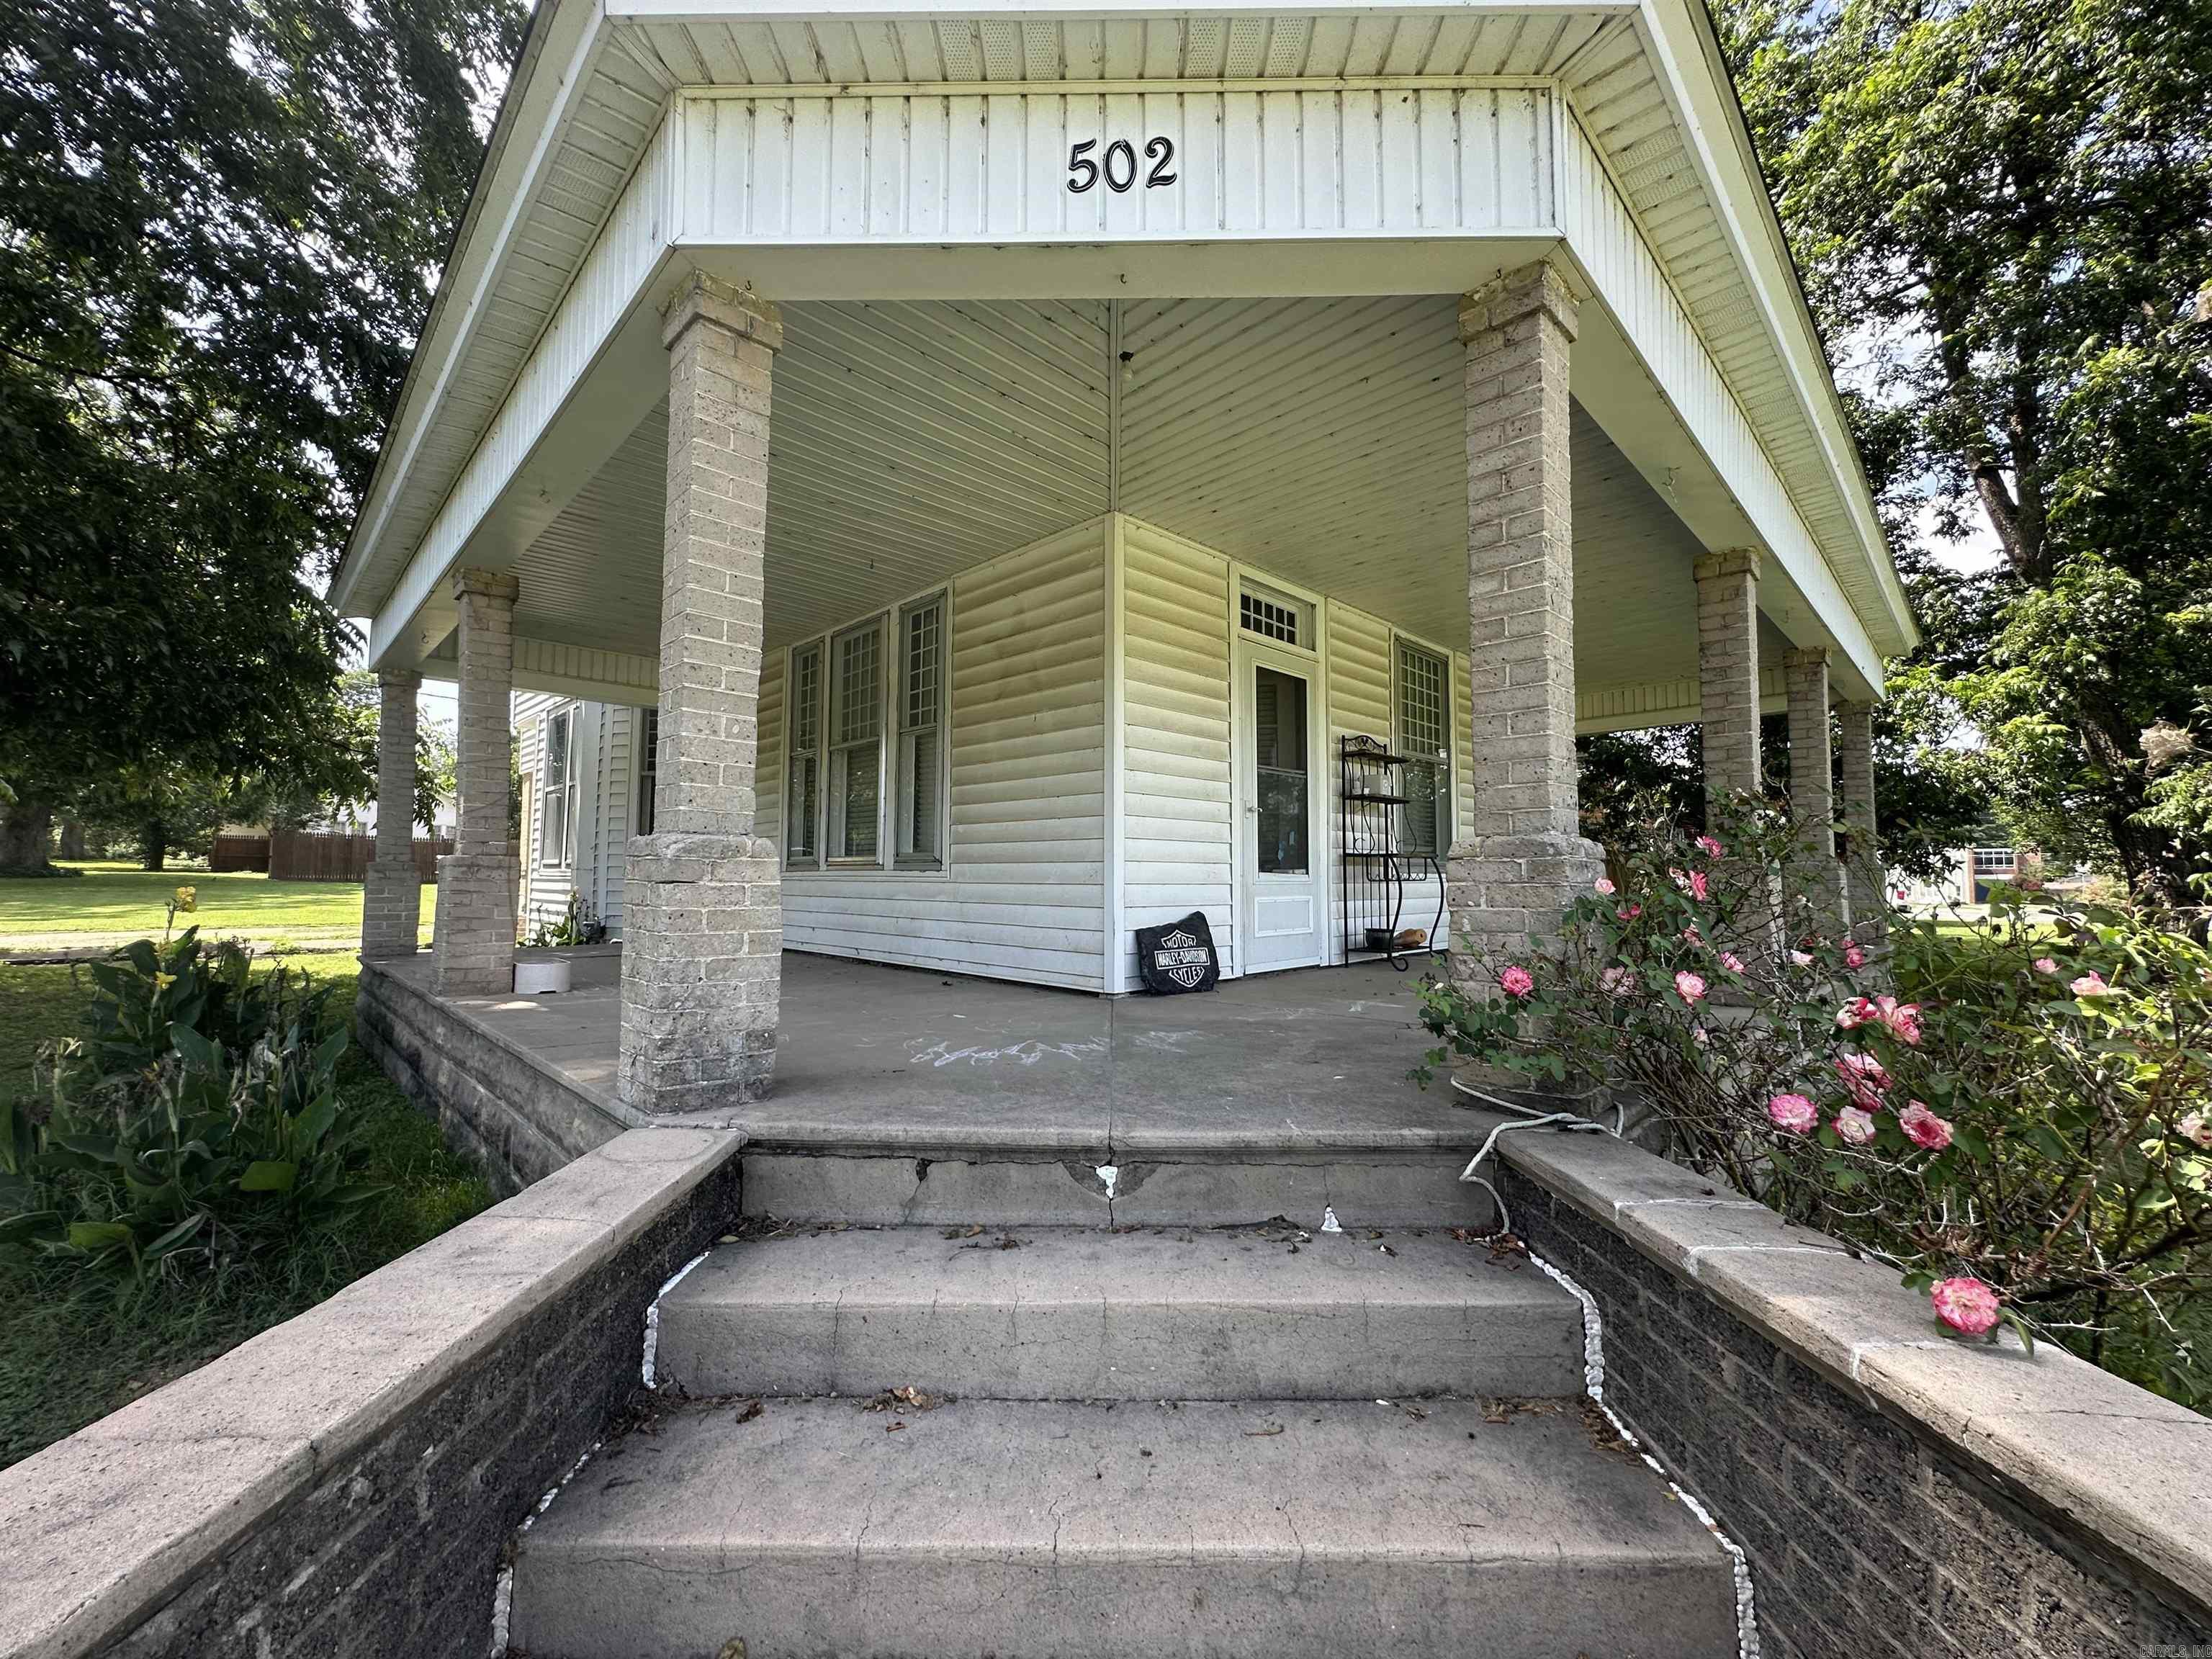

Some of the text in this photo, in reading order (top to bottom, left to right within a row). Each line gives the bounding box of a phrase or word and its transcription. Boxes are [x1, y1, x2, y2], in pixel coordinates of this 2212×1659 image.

[1066, 136, 1177, 193] 502
[1166, 934, 1195, 948] MOTOR
[1157, 950, 1207, 966] HARLEY-DAVIDSON
[1174, 966, 1201, 984] CYCLES
